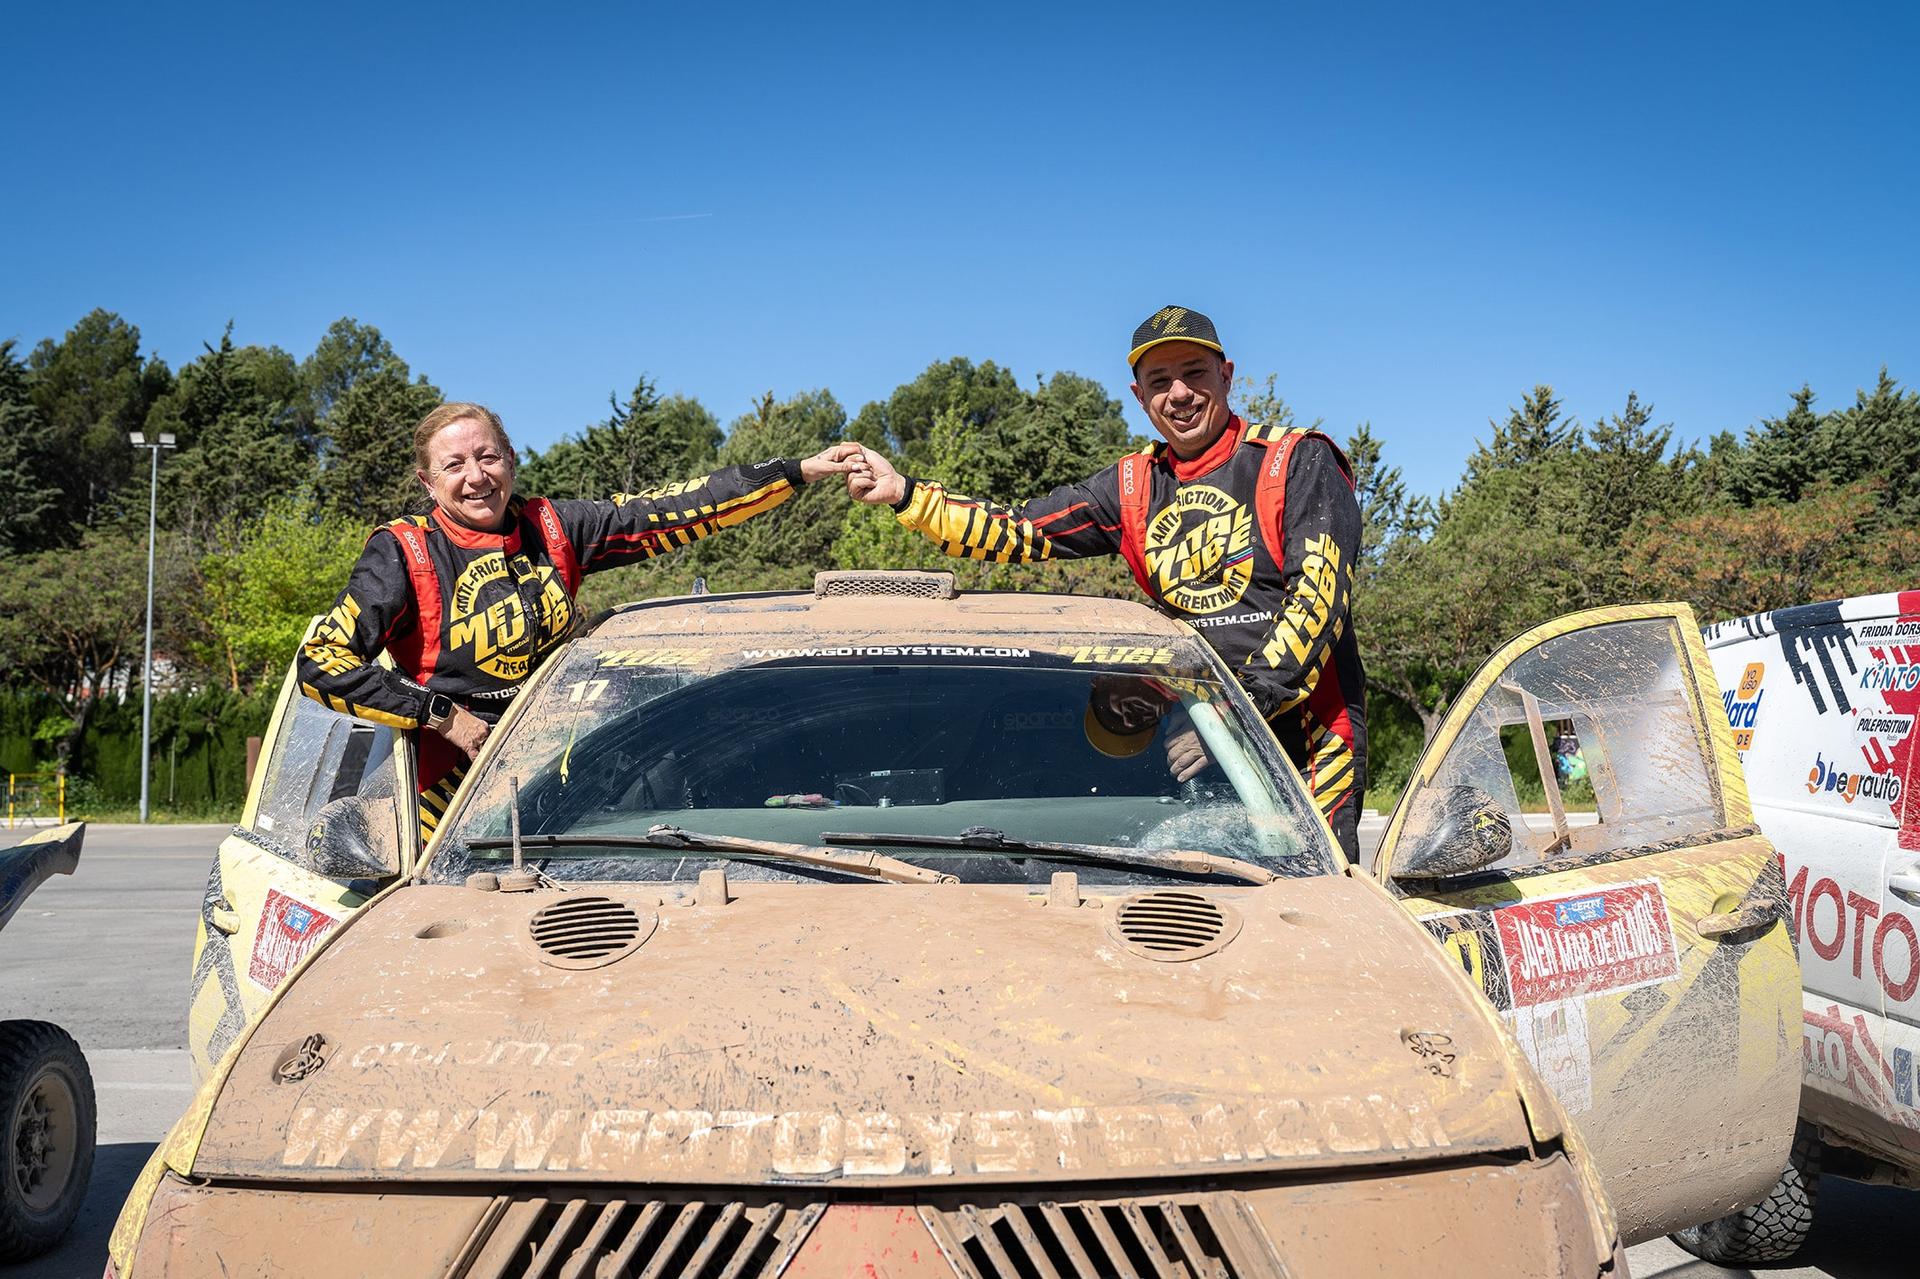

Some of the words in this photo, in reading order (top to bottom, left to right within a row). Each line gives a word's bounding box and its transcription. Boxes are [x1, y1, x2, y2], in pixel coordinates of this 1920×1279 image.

[402, 530, 426, 565] sparco
[1860, 625, 1893, 637] FRIDDA
[742, 646, 1031, 659] WWW.GOTOSYSTEM.COM
[567, 678, 611, 702] 17
[1824, 761, 1900, 804] begrauto
